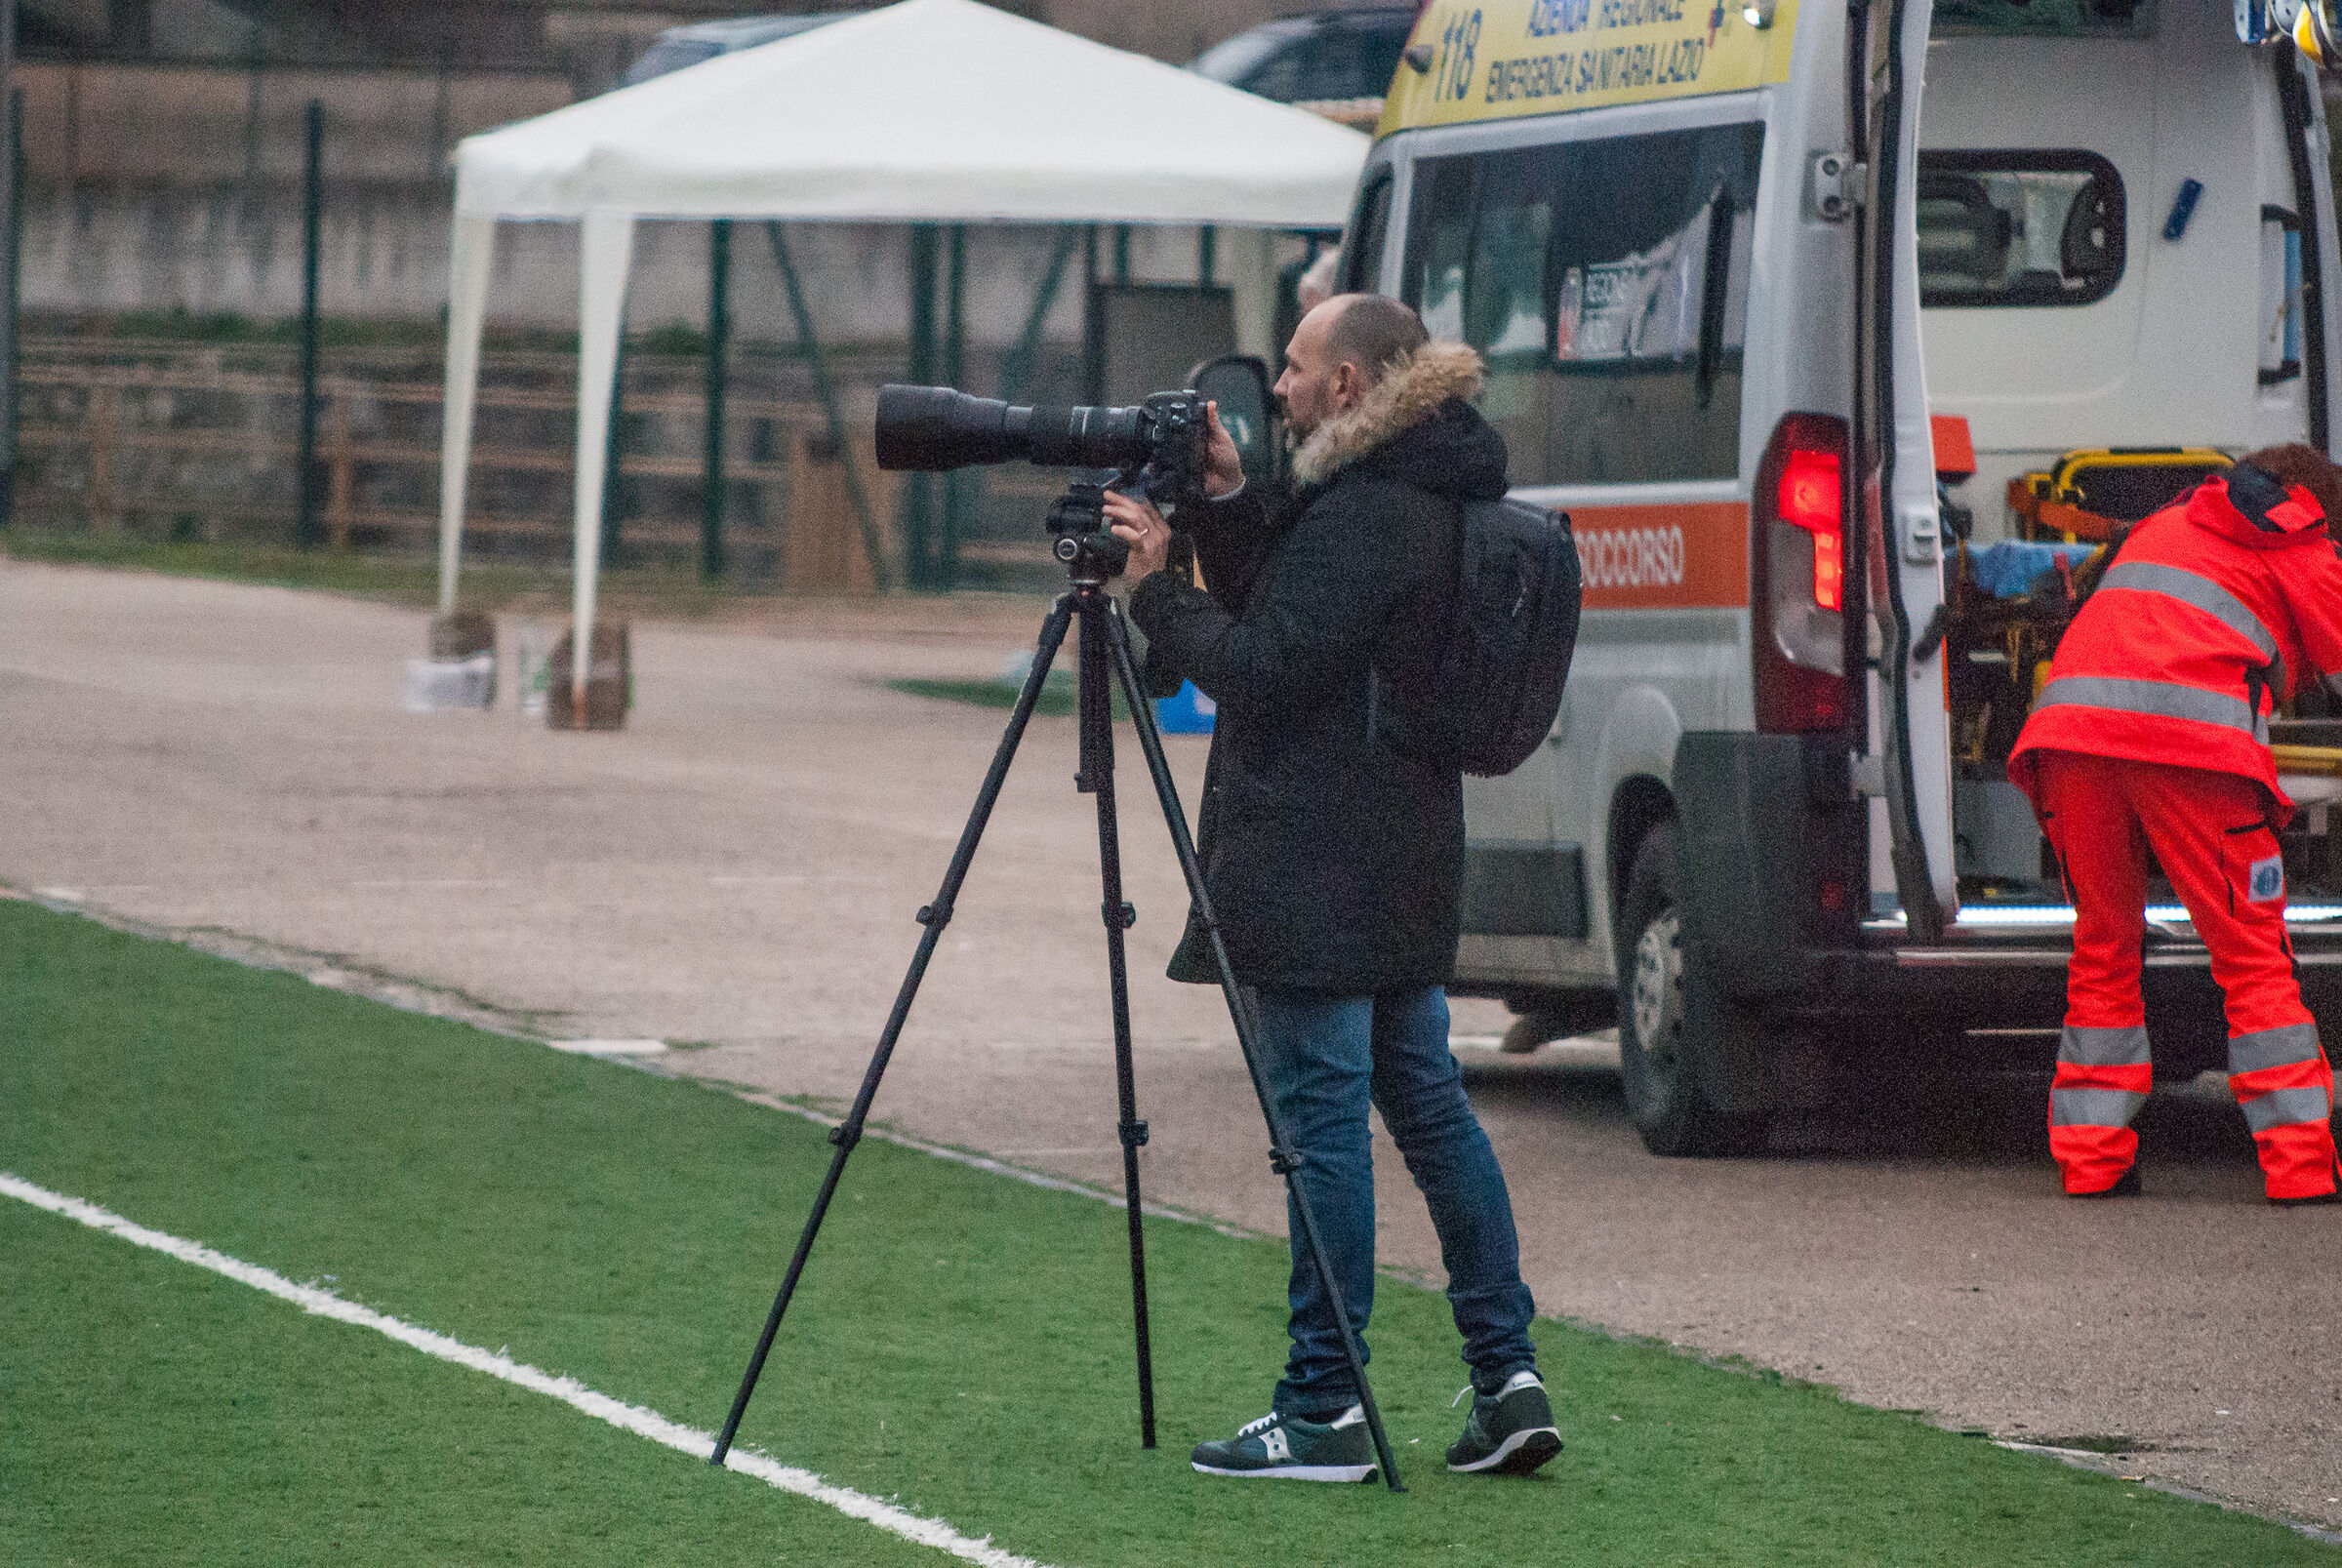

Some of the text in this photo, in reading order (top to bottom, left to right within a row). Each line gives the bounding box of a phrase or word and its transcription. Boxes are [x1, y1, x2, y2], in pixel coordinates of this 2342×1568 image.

[1435, 9, 1482, 102] 118
[1486, 38, 1705, 102] EMERGENZA SANITARIA LAZIO
